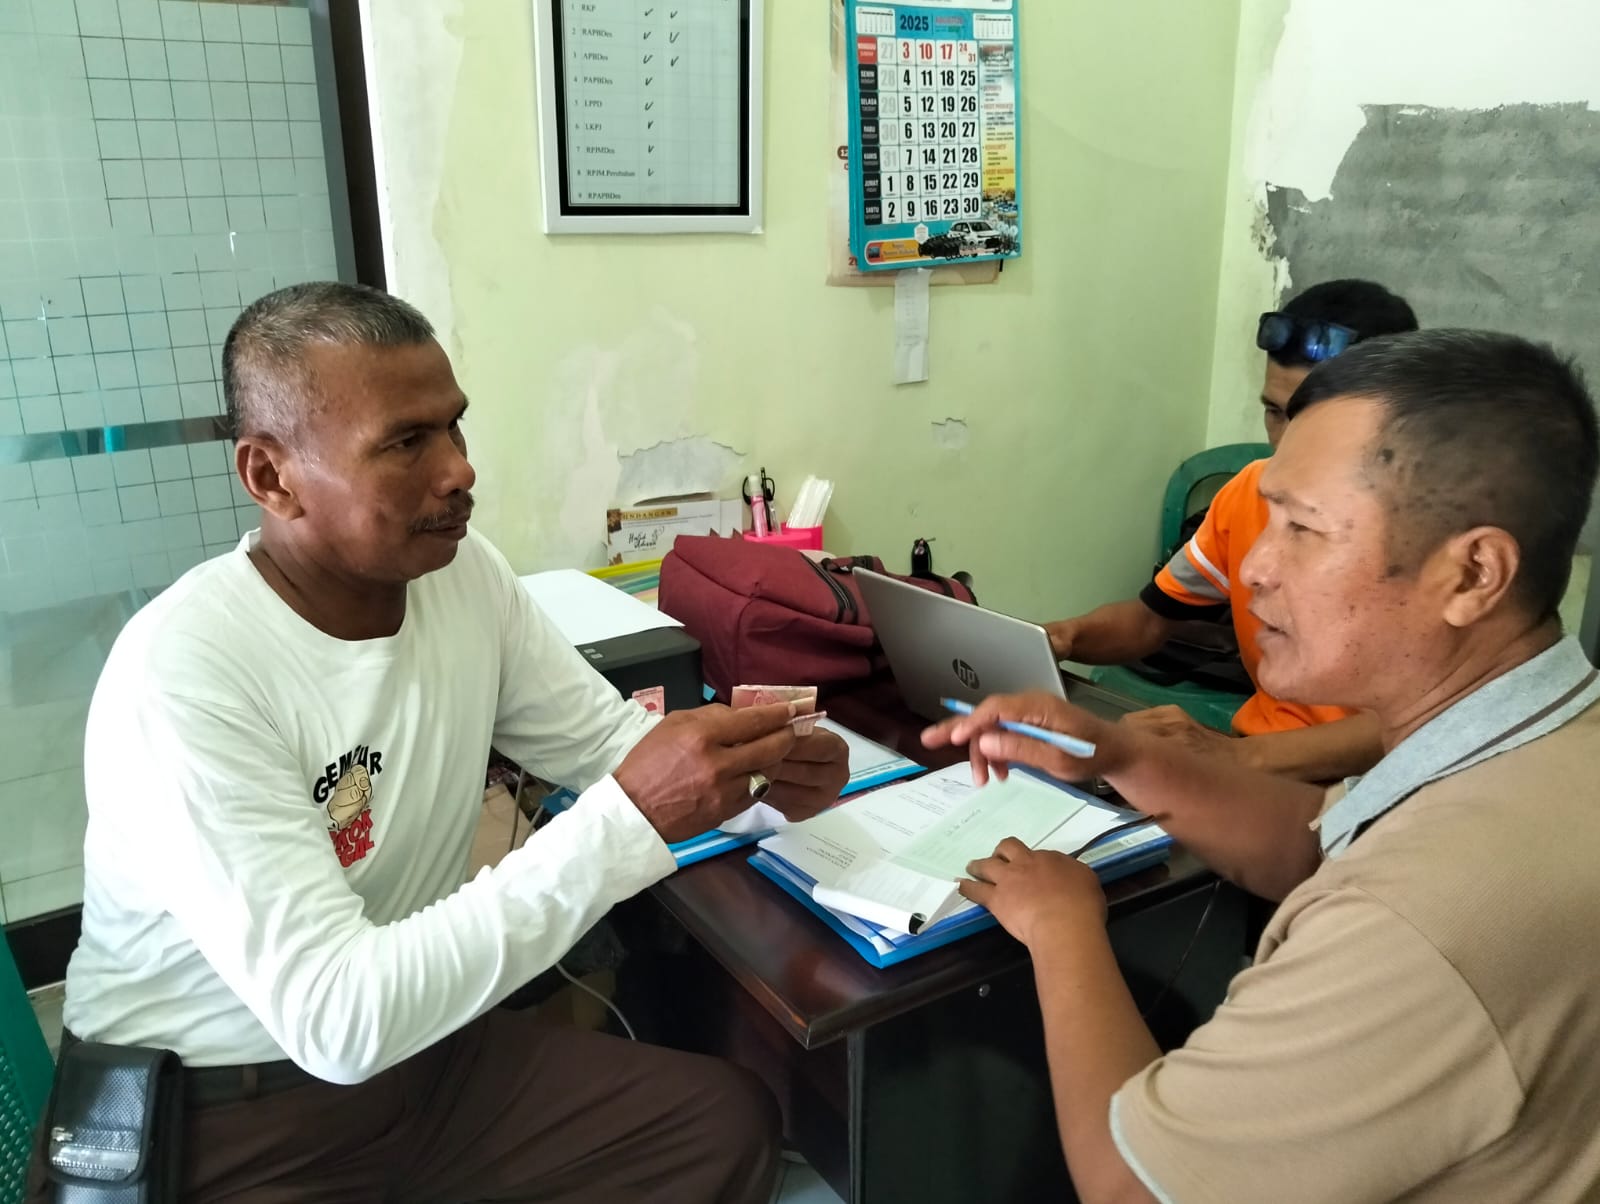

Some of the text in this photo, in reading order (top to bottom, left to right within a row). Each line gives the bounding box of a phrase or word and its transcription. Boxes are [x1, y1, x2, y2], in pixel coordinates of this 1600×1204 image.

[899, 15, 929, 32] 2025
[881, 43, 893, 60] 27
[902, 42, 910, 59] 3
[919, 44, 933, 60] 10
[940, 44, 953, 60] 17
[959, 43, 968, 53] 24
[968, 54, 976, 63] 31
[881, 70, 895, 87] 28
[903, 70, 911, 86] 4
[921, 71, 933, 86] 11
[940, 71, 955, 87] 18
[960, 71, 976, 87] 25
[881, 97, 896, 114] 29
[903, 96, 912, 113] 5
[921, 97, 934, 113] 12
[941, 97, 955, 113] 19
[960, 96, 977, 112] 26
[881, 124, 896, 141] 30
[904, 123, 913, 139] 6
[921, 123, 936, 139] 13
[940, 122, 957, 138] 20
[962, 122, 976, 138] 27
[884, 150, 897, 168] 31
[906, 149, 913, 166] 7
[922, 149, 936, 165] 14
[942, 148, 956, 164] 21
[961, 147, 978, 163] 28
[887, 176, 893, 192] 1
[906, 175, 914, 192] 8
[923, 175, 937, 191] 15
[942, 174, 958, 190] 22
[962, 173, 979, 188] 29
[887, 202, 896, 219] 2
[907, 201, 915, 217] 9
[924, 200, 938, 216] 16
[943, 199, 959, 215] 23
[963, 198, 979, 214] 30
